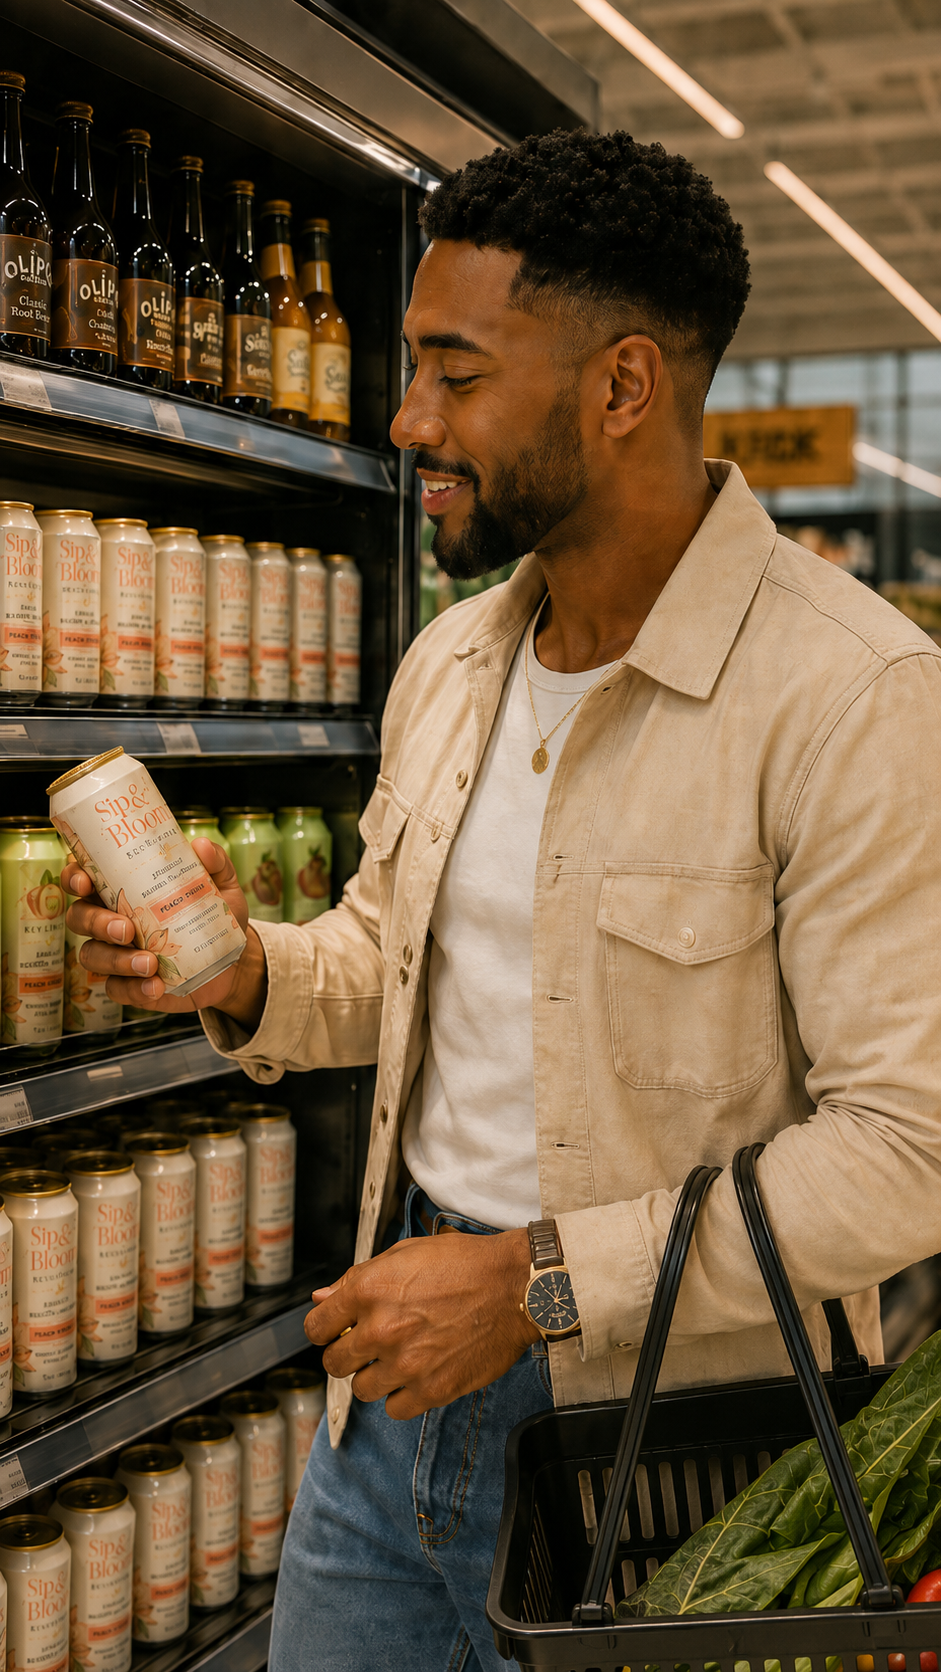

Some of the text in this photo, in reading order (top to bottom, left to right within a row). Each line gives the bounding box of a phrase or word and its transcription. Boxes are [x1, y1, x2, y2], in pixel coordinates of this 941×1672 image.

[5, 533, 41, 559] Sip&
[60, 539, 96, 565] Sip&
[117, 546, 151, 571] Sip&
[94, 783, 150, 823] Sip&
[104, 805, 172, 849] Bloom
[97, 1201, 134, 1226] Sip&
[30, 1223, 72, 1250] Sip&
[27, 1571, 65, 1599] Sip&
